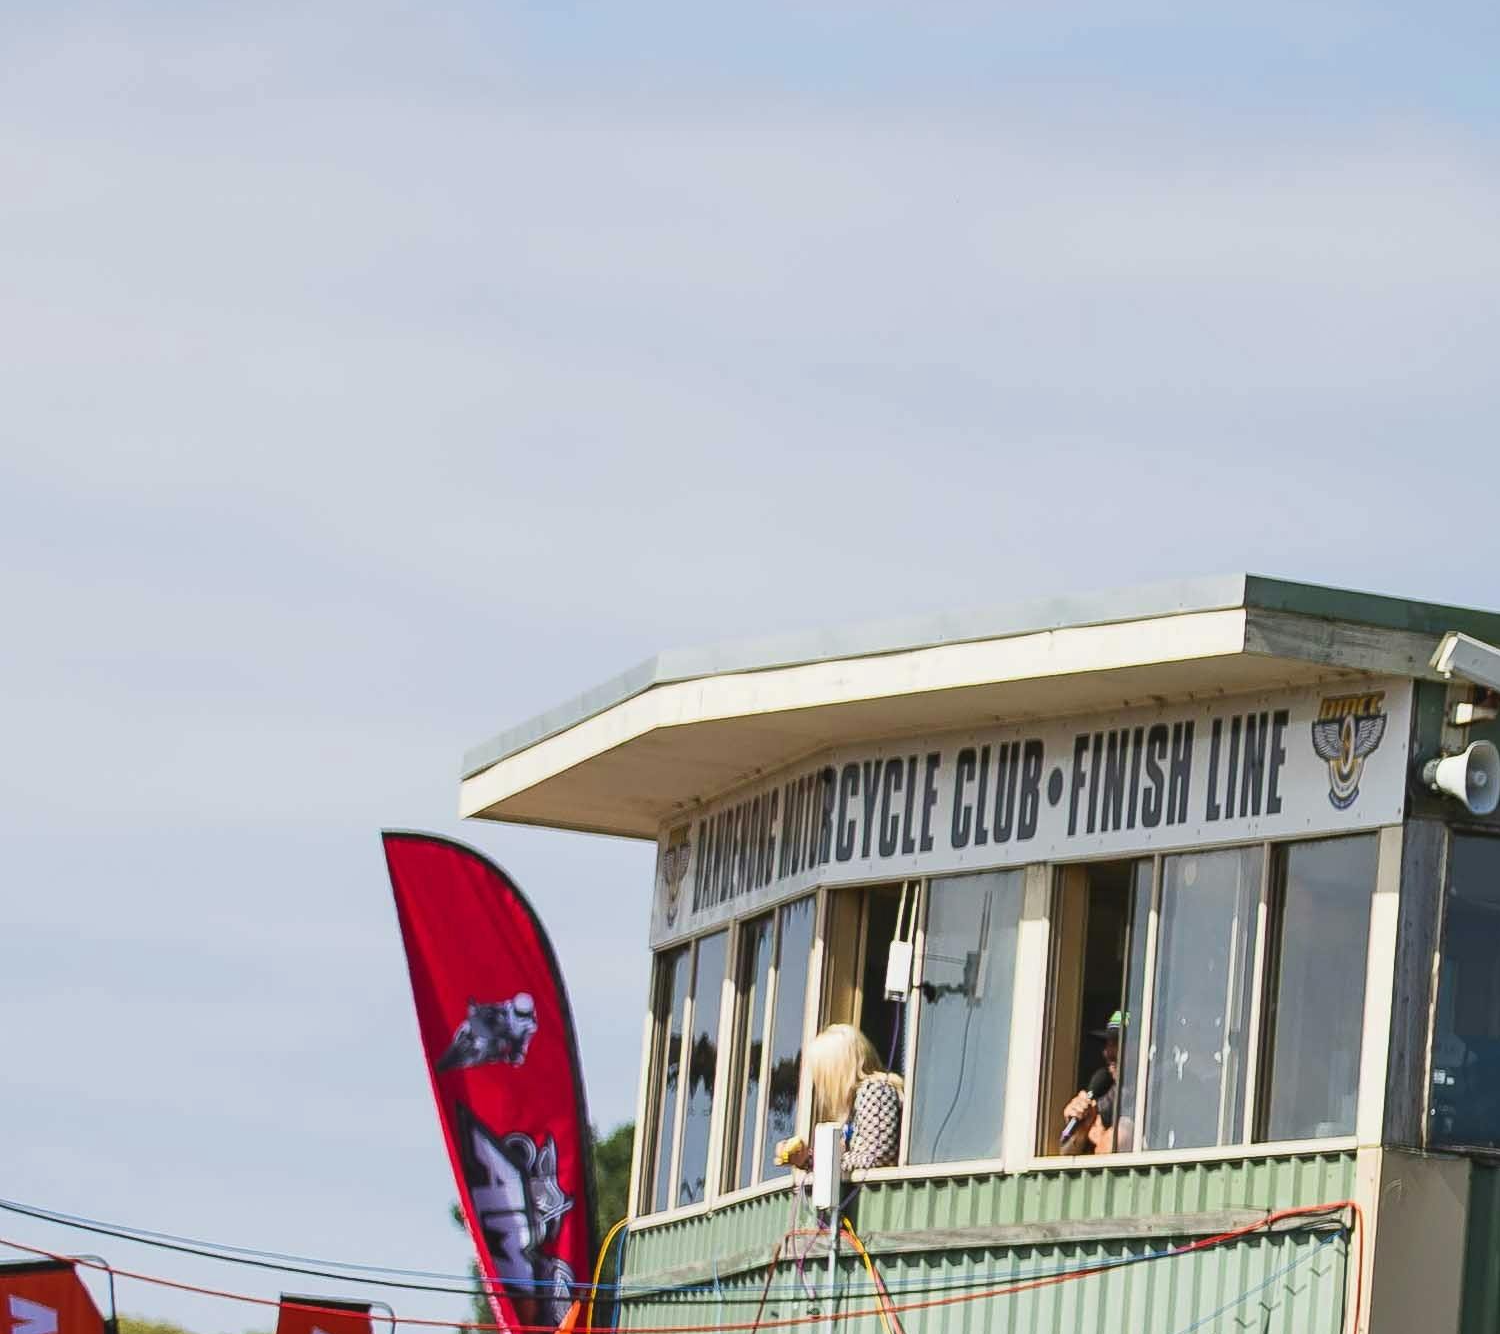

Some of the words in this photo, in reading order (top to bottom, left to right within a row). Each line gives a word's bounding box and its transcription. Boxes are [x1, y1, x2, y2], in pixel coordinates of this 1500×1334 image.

[777, 750, 943, 882] MOTORCYCLE
[950, 737, 1046, 850] CLUB
[1066, 720, 1197, 837] FINISH
[1205, 708, 1290, 823] LINE
